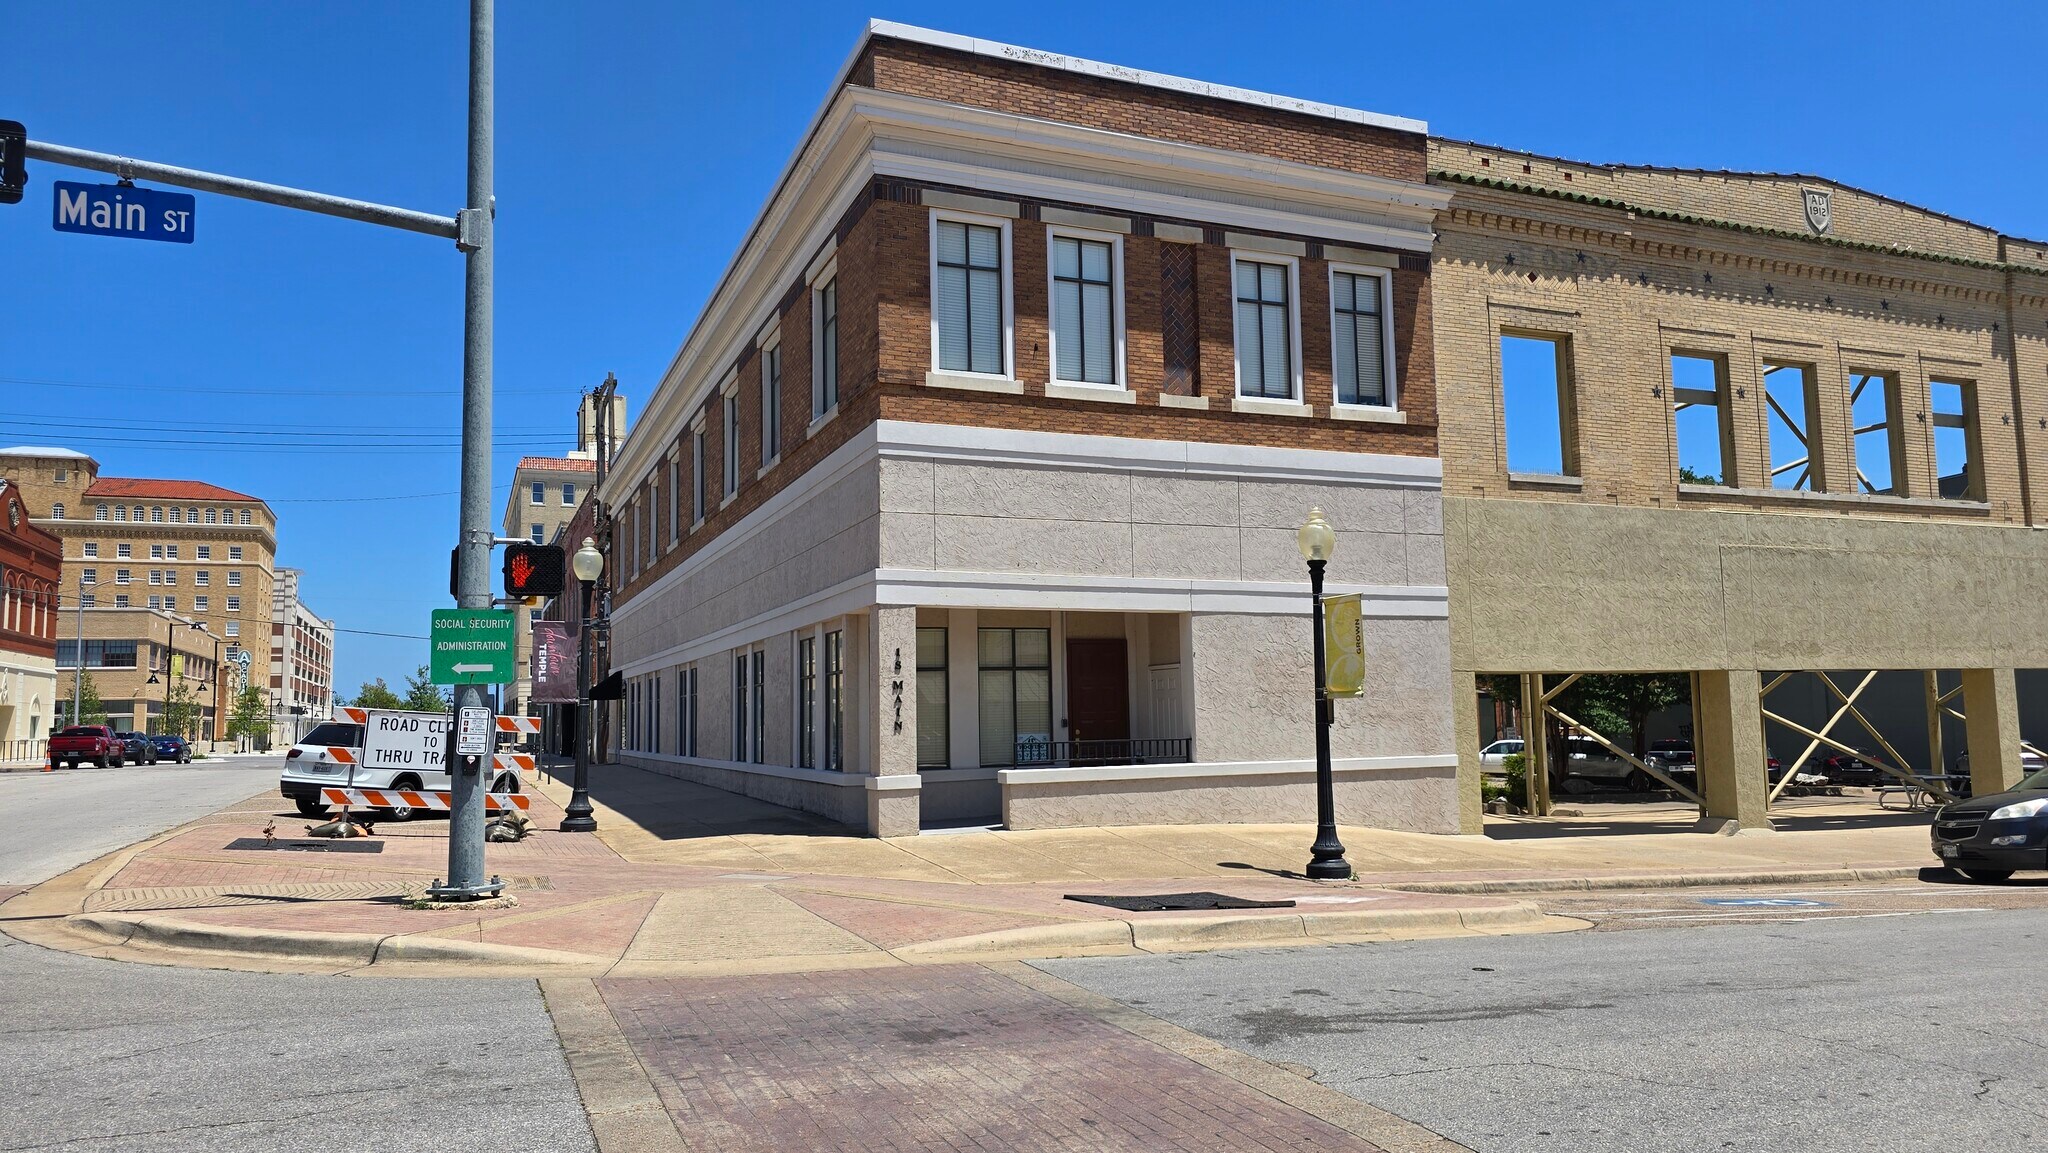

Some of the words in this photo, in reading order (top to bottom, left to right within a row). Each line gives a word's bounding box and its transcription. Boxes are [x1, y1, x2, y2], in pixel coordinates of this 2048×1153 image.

[59, 189, 145, 231] Main
[163, 210, 189, 232] ST
[1809, 206, 1826, 217] 1912
[435, 619, 466, 629] SOCIAL
[469, 619, 511, 629] SECURITY
[437, 641, 507, 651] ADMINISTRATION
[538, 643, 547, 682] TEMPLE
[891, 680, 904, 732] MAIN
[380, 717, 419, 732] ROAD
[423, 736, 438, 748] TO
[375, 748, 413, 763] THRU
